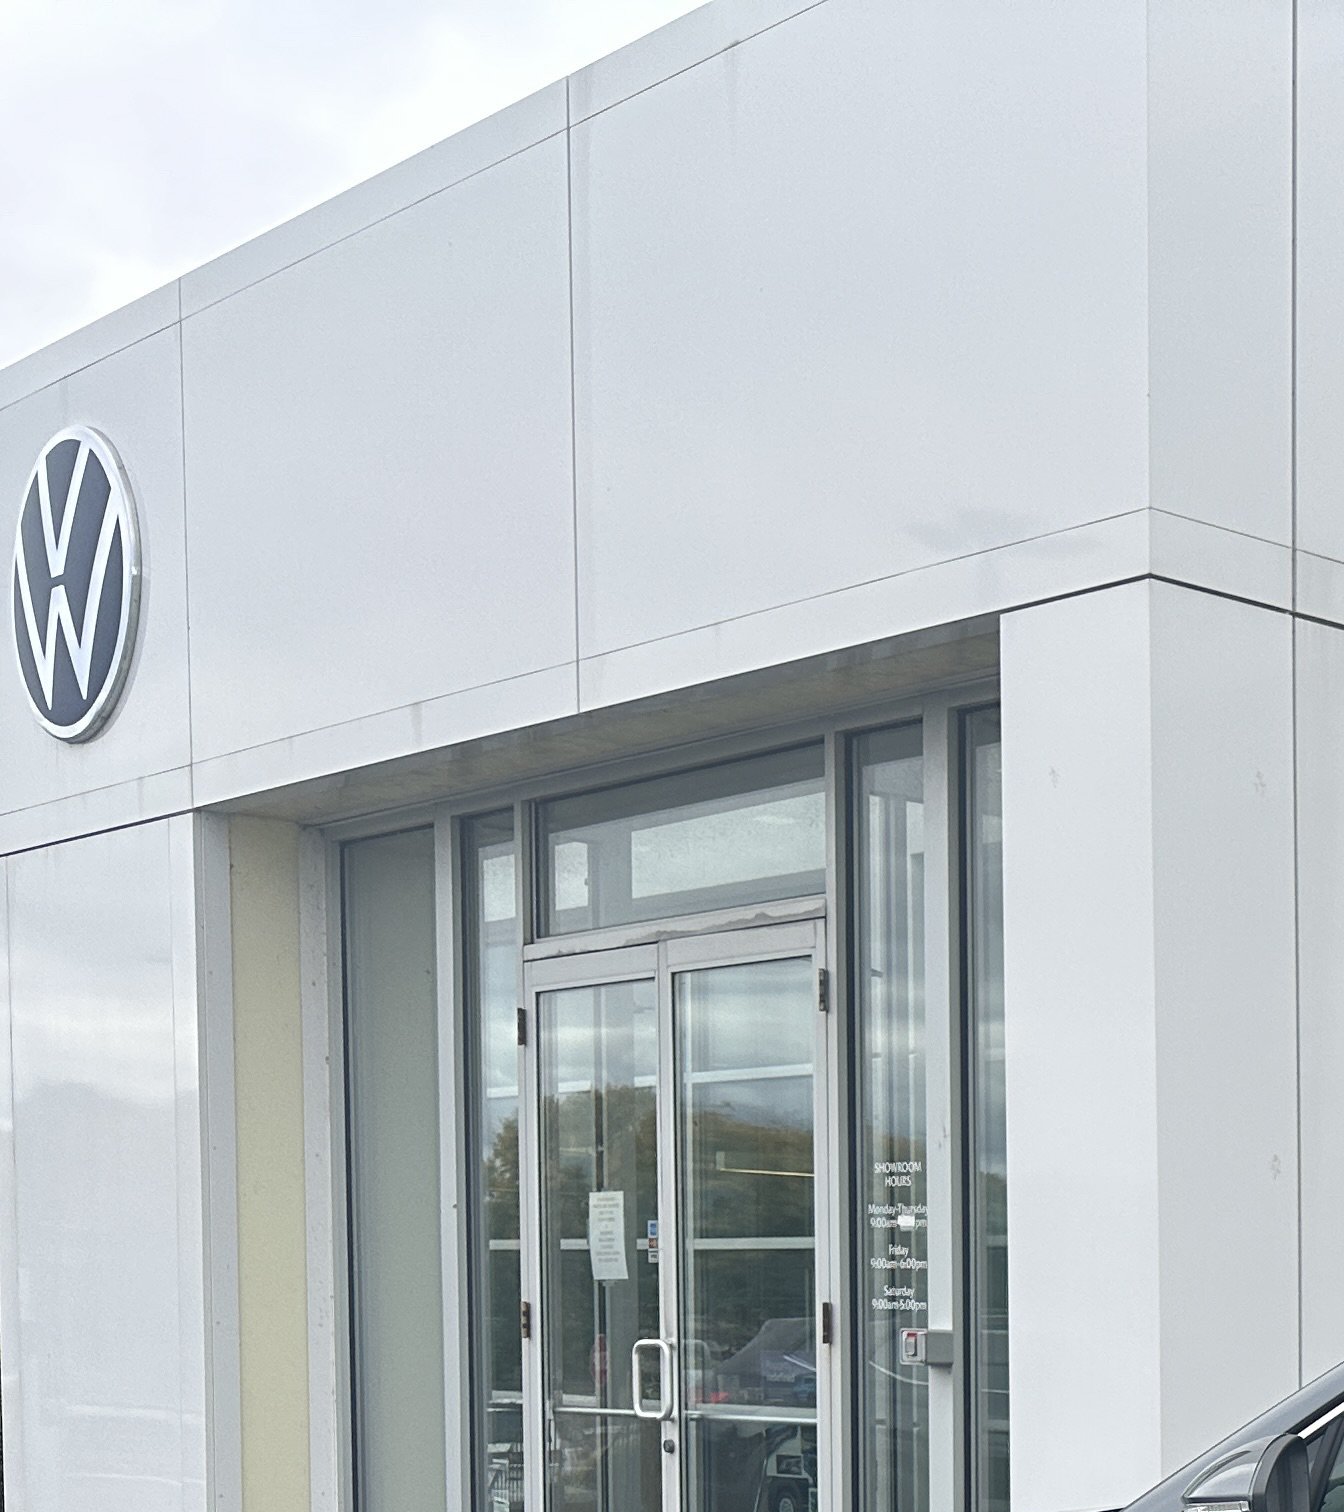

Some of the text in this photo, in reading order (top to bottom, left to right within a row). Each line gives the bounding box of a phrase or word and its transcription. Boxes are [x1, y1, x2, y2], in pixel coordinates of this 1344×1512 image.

[874, 1161, 923, 1174] SHOWROOM
[884, 1175, 912, 1187] HOURS
[867, 1203, 928, 1218] Monday-Thursday
[888, 1244, 909, 1258] Friday
[870, 1257, 928, 1271] 9:00am-6:00pm
[883, 1285, 915, 1299] Saturday
[871, 1298, 927, 1312] 9:00am-5:00pm
